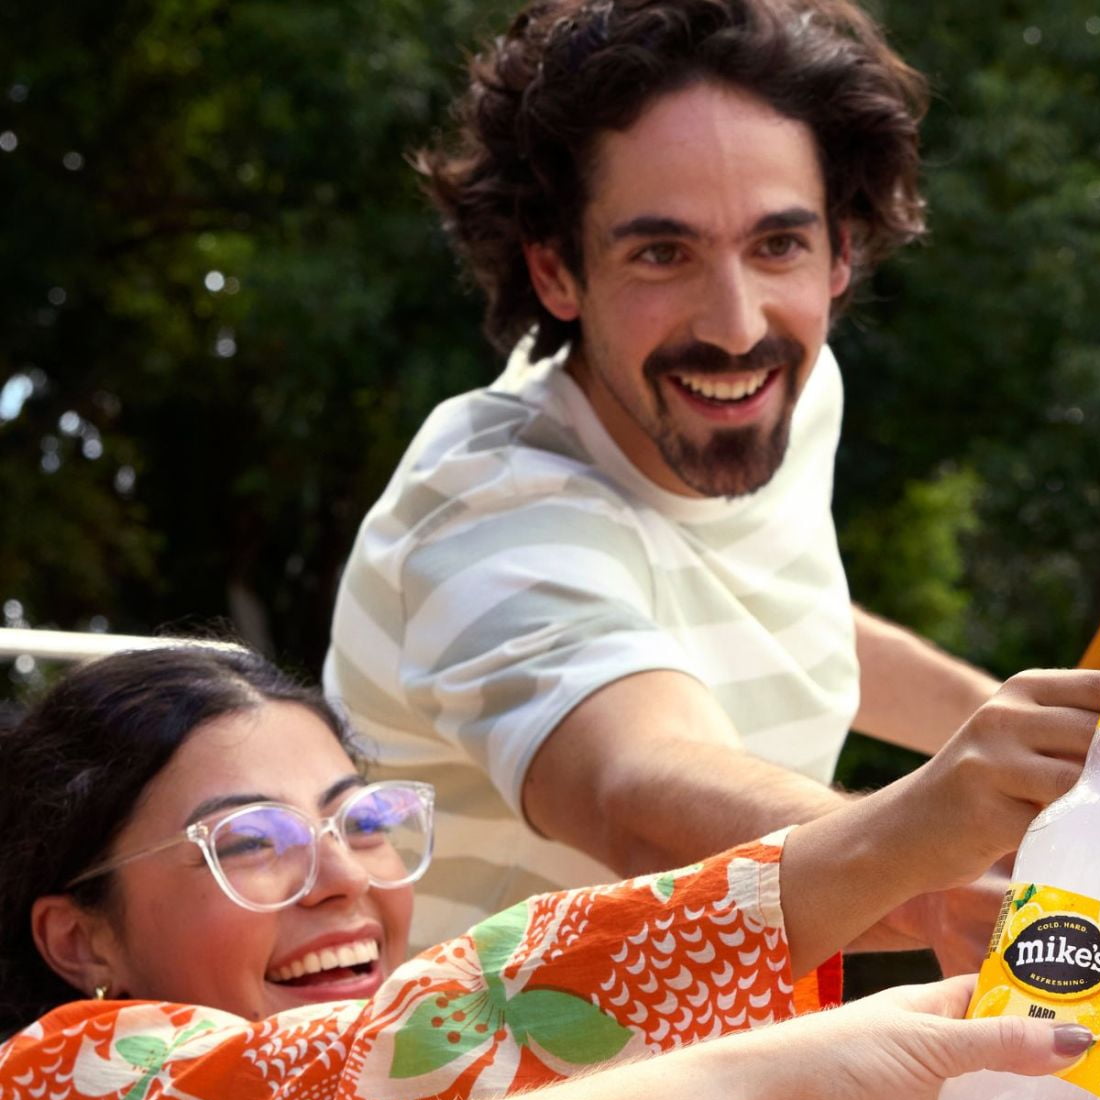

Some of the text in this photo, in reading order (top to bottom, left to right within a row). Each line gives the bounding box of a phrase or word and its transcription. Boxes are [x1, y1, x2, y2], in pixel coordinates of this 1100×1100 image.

[1037, 922, 1088, 934] COLD. HARD.
[1030, 973, 1089, 987] REFRESHING.
[1028, 1004, 1056, 1020] HARD
